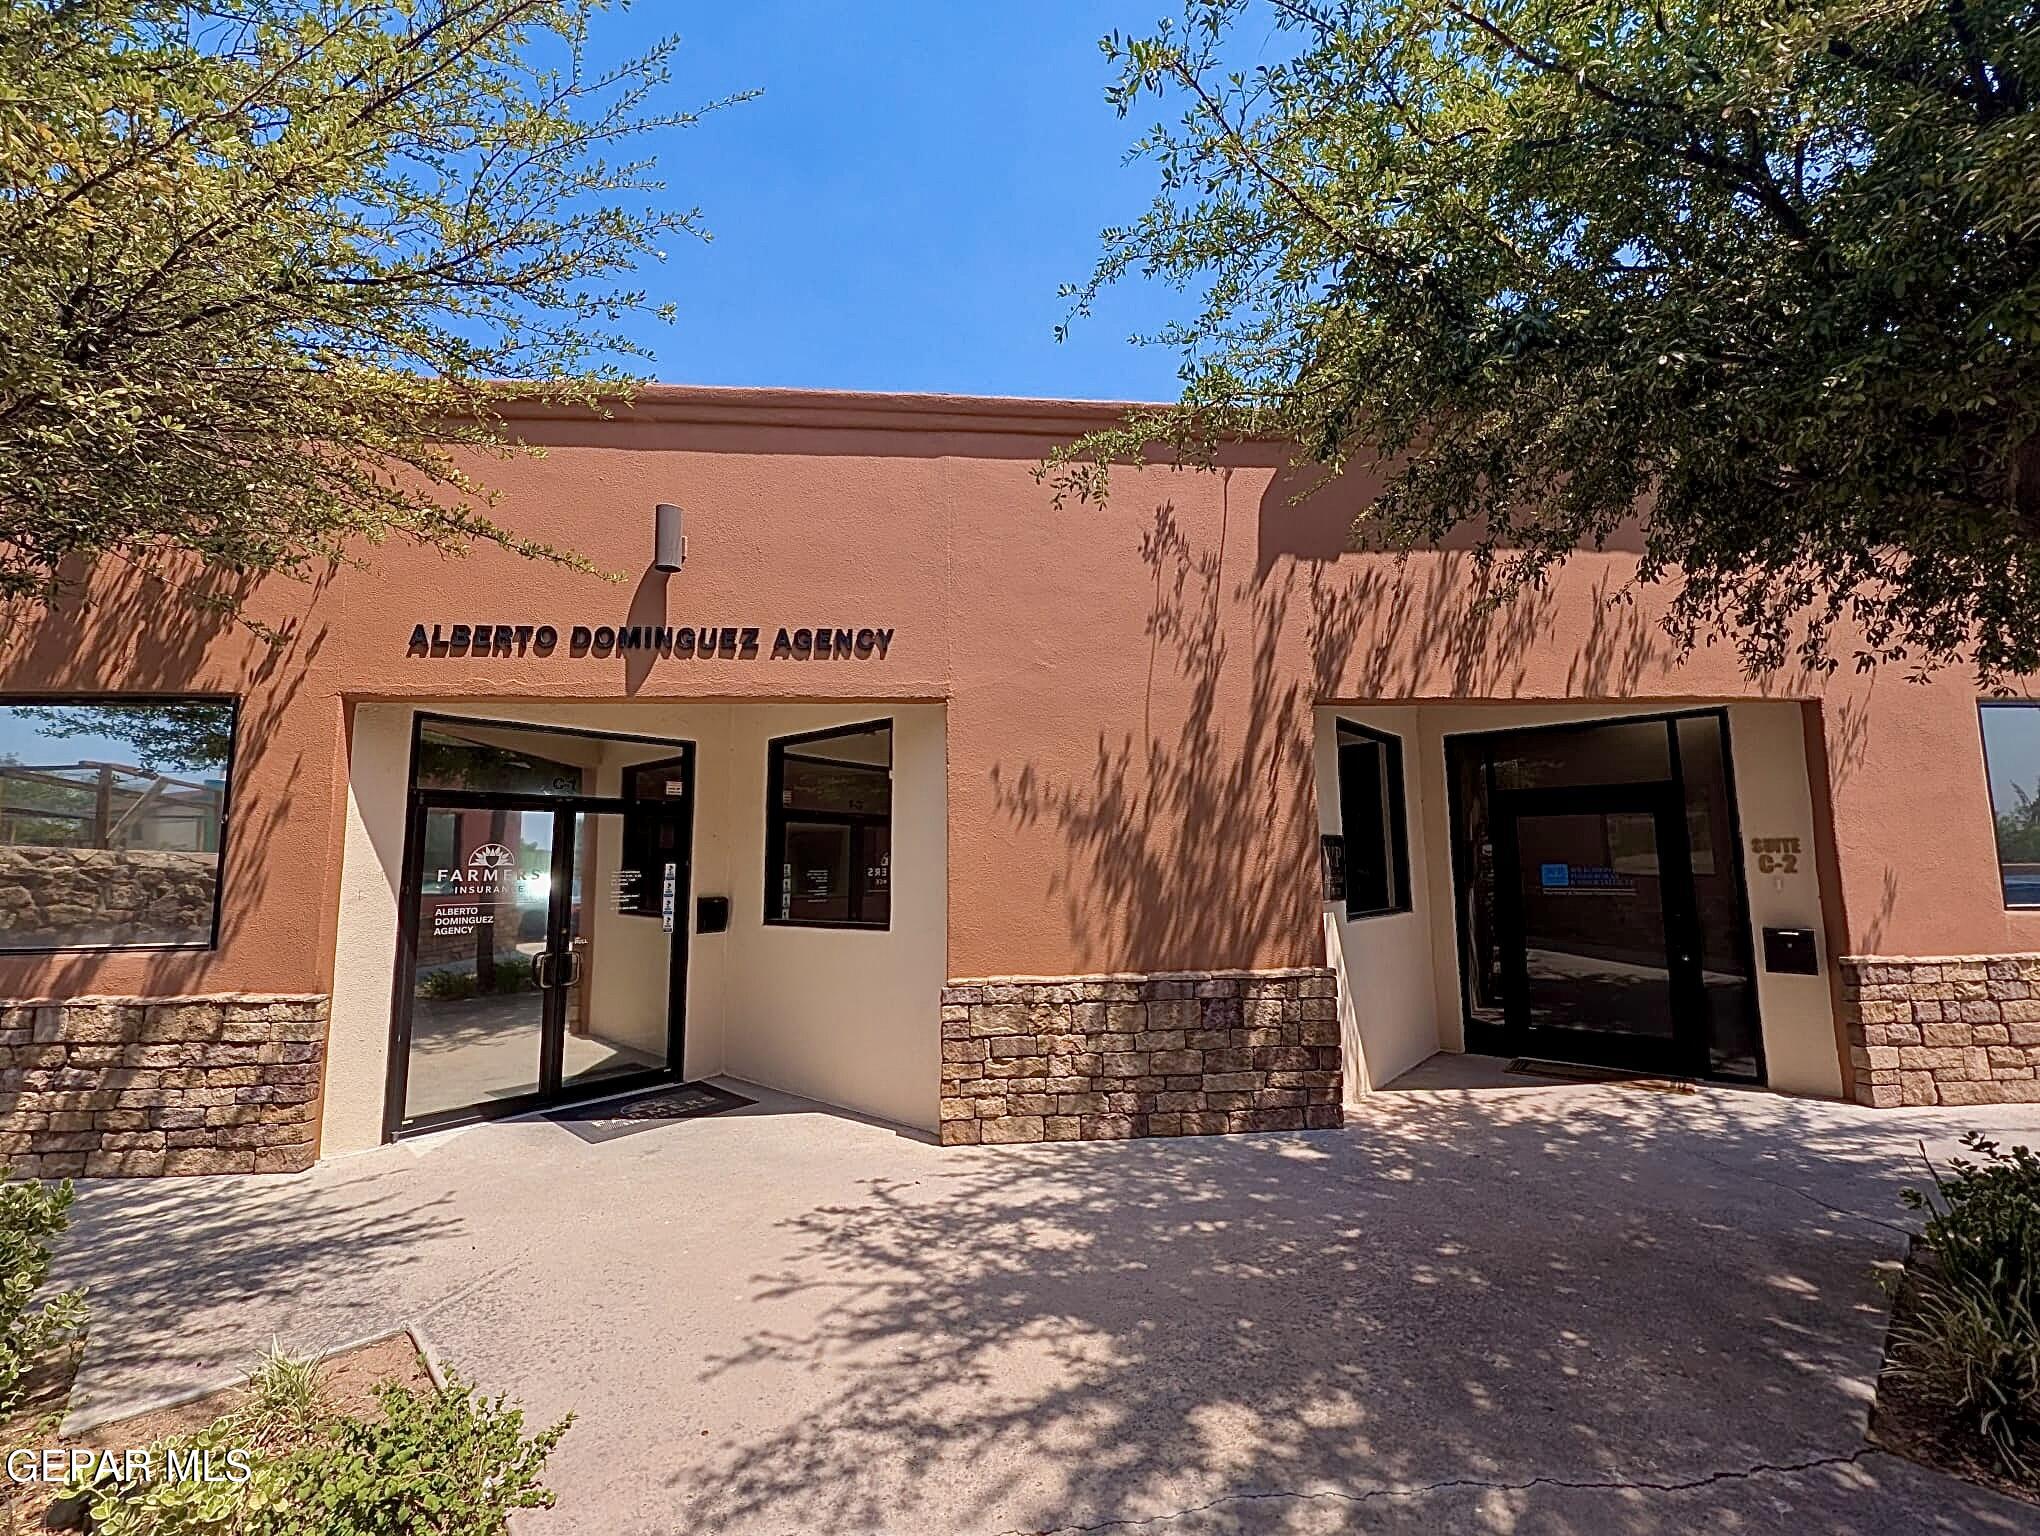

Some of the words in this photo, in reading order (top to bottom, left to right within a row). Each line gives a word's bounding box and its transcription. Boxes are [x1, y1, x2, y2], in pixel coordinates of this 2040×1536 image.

[407, 624, 558, 651] ALBERTO
[570, 625, 760, 652] DOMINGUEZ
[772, 627, 895, 653] AGENCY
[1758, 854, 1798, 873] C-2
[437, 869, 541, 882] FARMERS
[455, 885, 525, 894] INSURANE
[435, 907, 478, 916] ALBERTO
[435, 916, 494, 925] DOMINGUEZ
[433, 926, 474, 935] AGENCY
